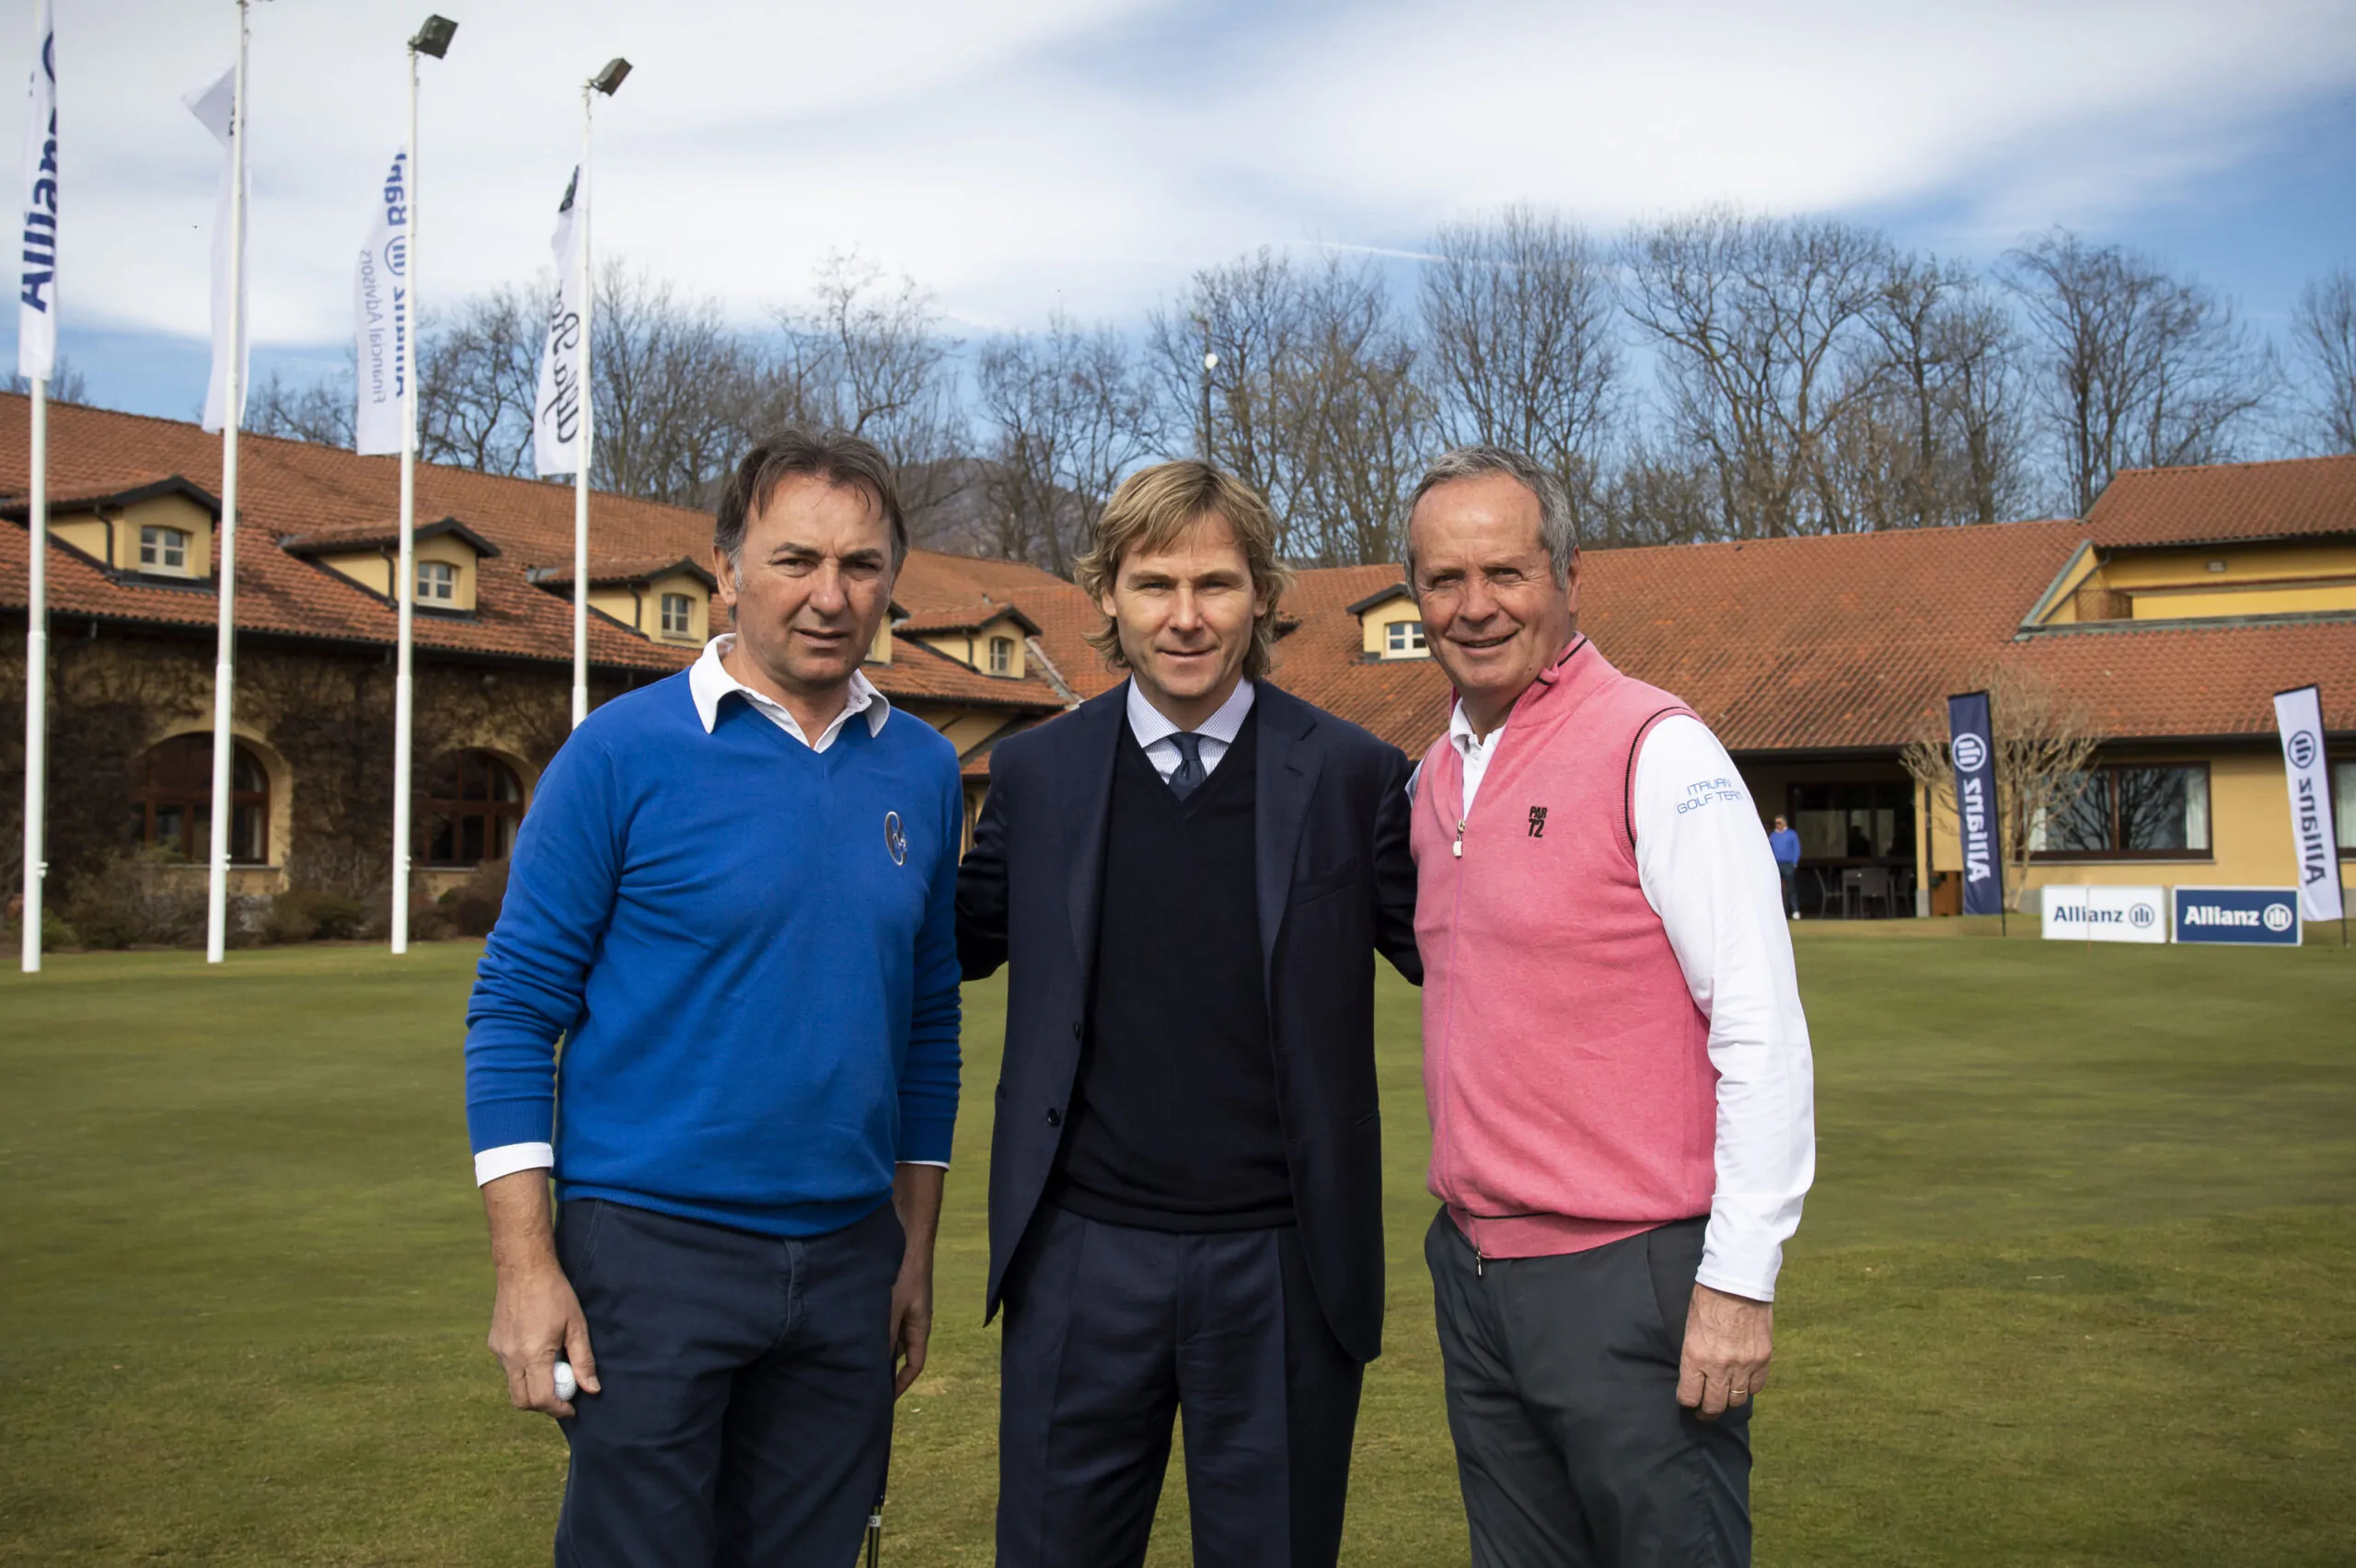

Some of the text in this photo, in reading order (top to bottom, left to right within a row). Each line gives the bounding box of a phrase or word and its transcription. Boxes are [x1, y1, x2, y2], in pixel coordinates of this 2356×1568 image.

[21, 108, 58, 315] Allian
[1687, 778, 1731, 796] ITALIAN
[1677, 790, 1744, 814] GOLF TEAM
[1529, 806, 1548, 819] PAR
[2053, 906, 2123, 923] Allianz
[2184, 905, 2259, 926] Allianz
